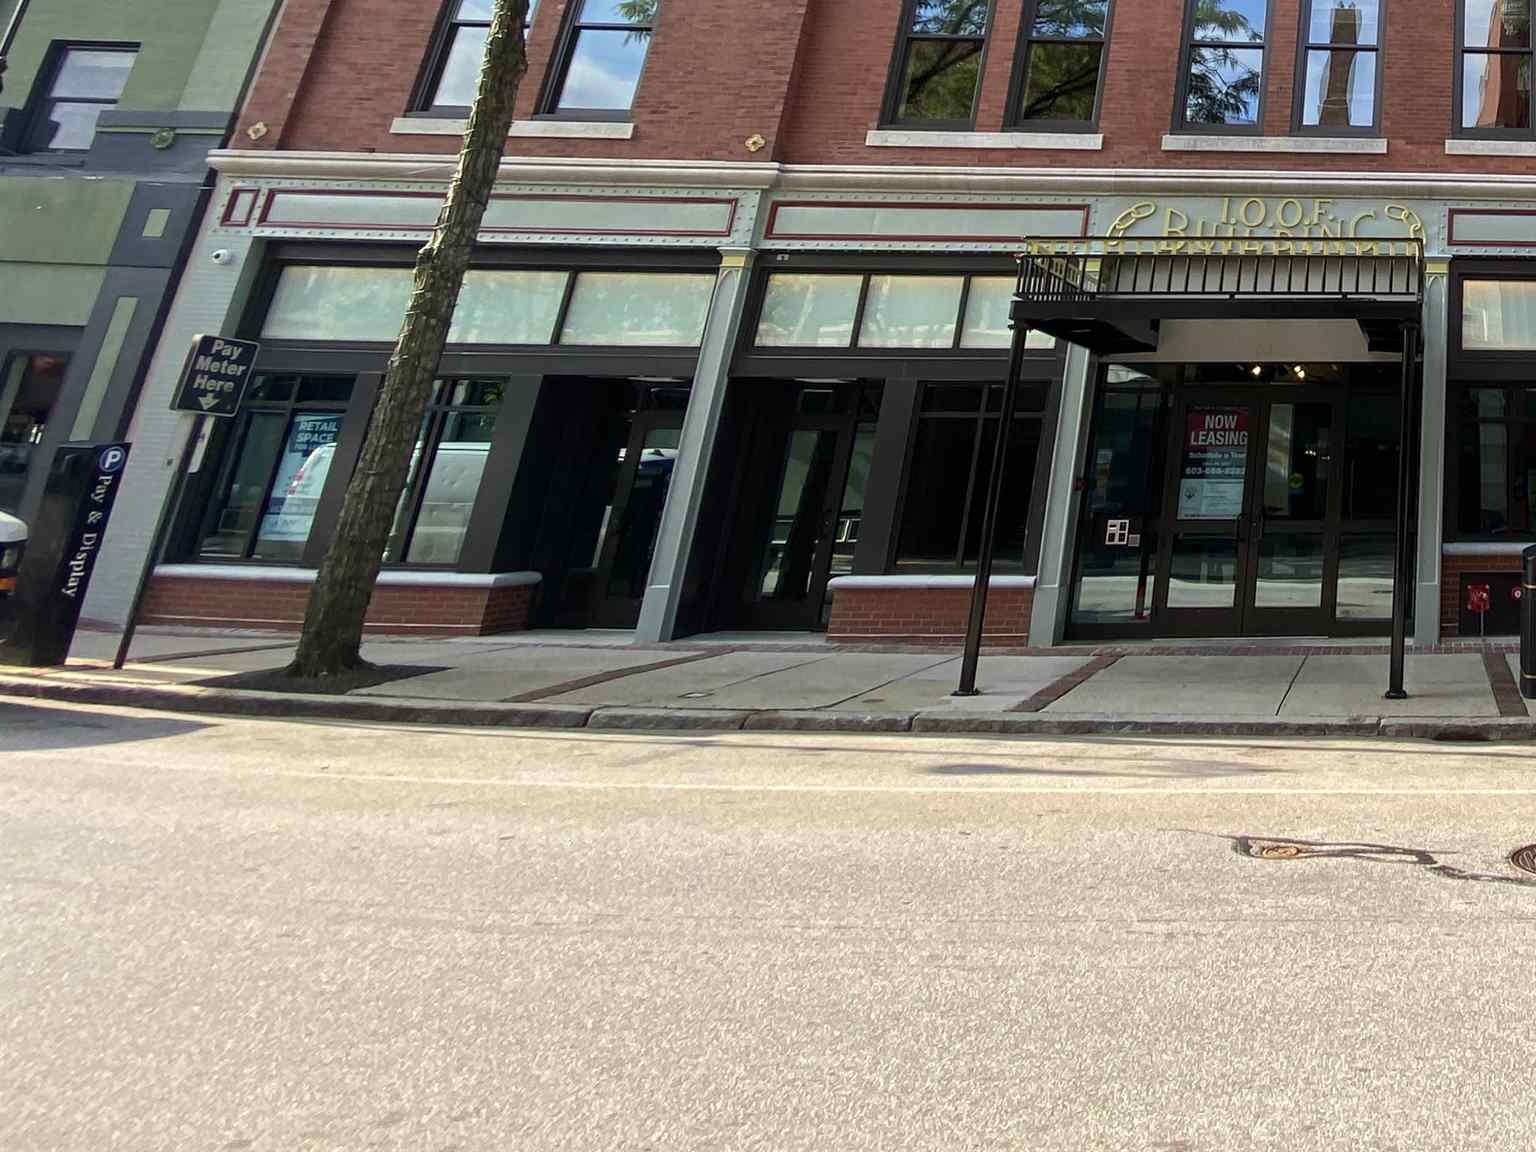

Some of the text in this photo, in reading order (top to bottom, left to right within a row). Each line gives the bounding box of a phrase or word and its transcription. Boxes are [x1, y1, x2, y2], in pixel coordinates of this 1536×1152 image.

[211, 339, 244, 360] Pay
[194, 355, 247, 376] Meter
[193, 374, 234, 393] Here
[298, 421, 338, 432] RETAIL
[1205, 415, 1238, 430] NOW
[295, 432, 334, 443] SPACE
[1190, 431, 1249, 446] LEASING
[61, 475, 113, 598] Pay & Display
